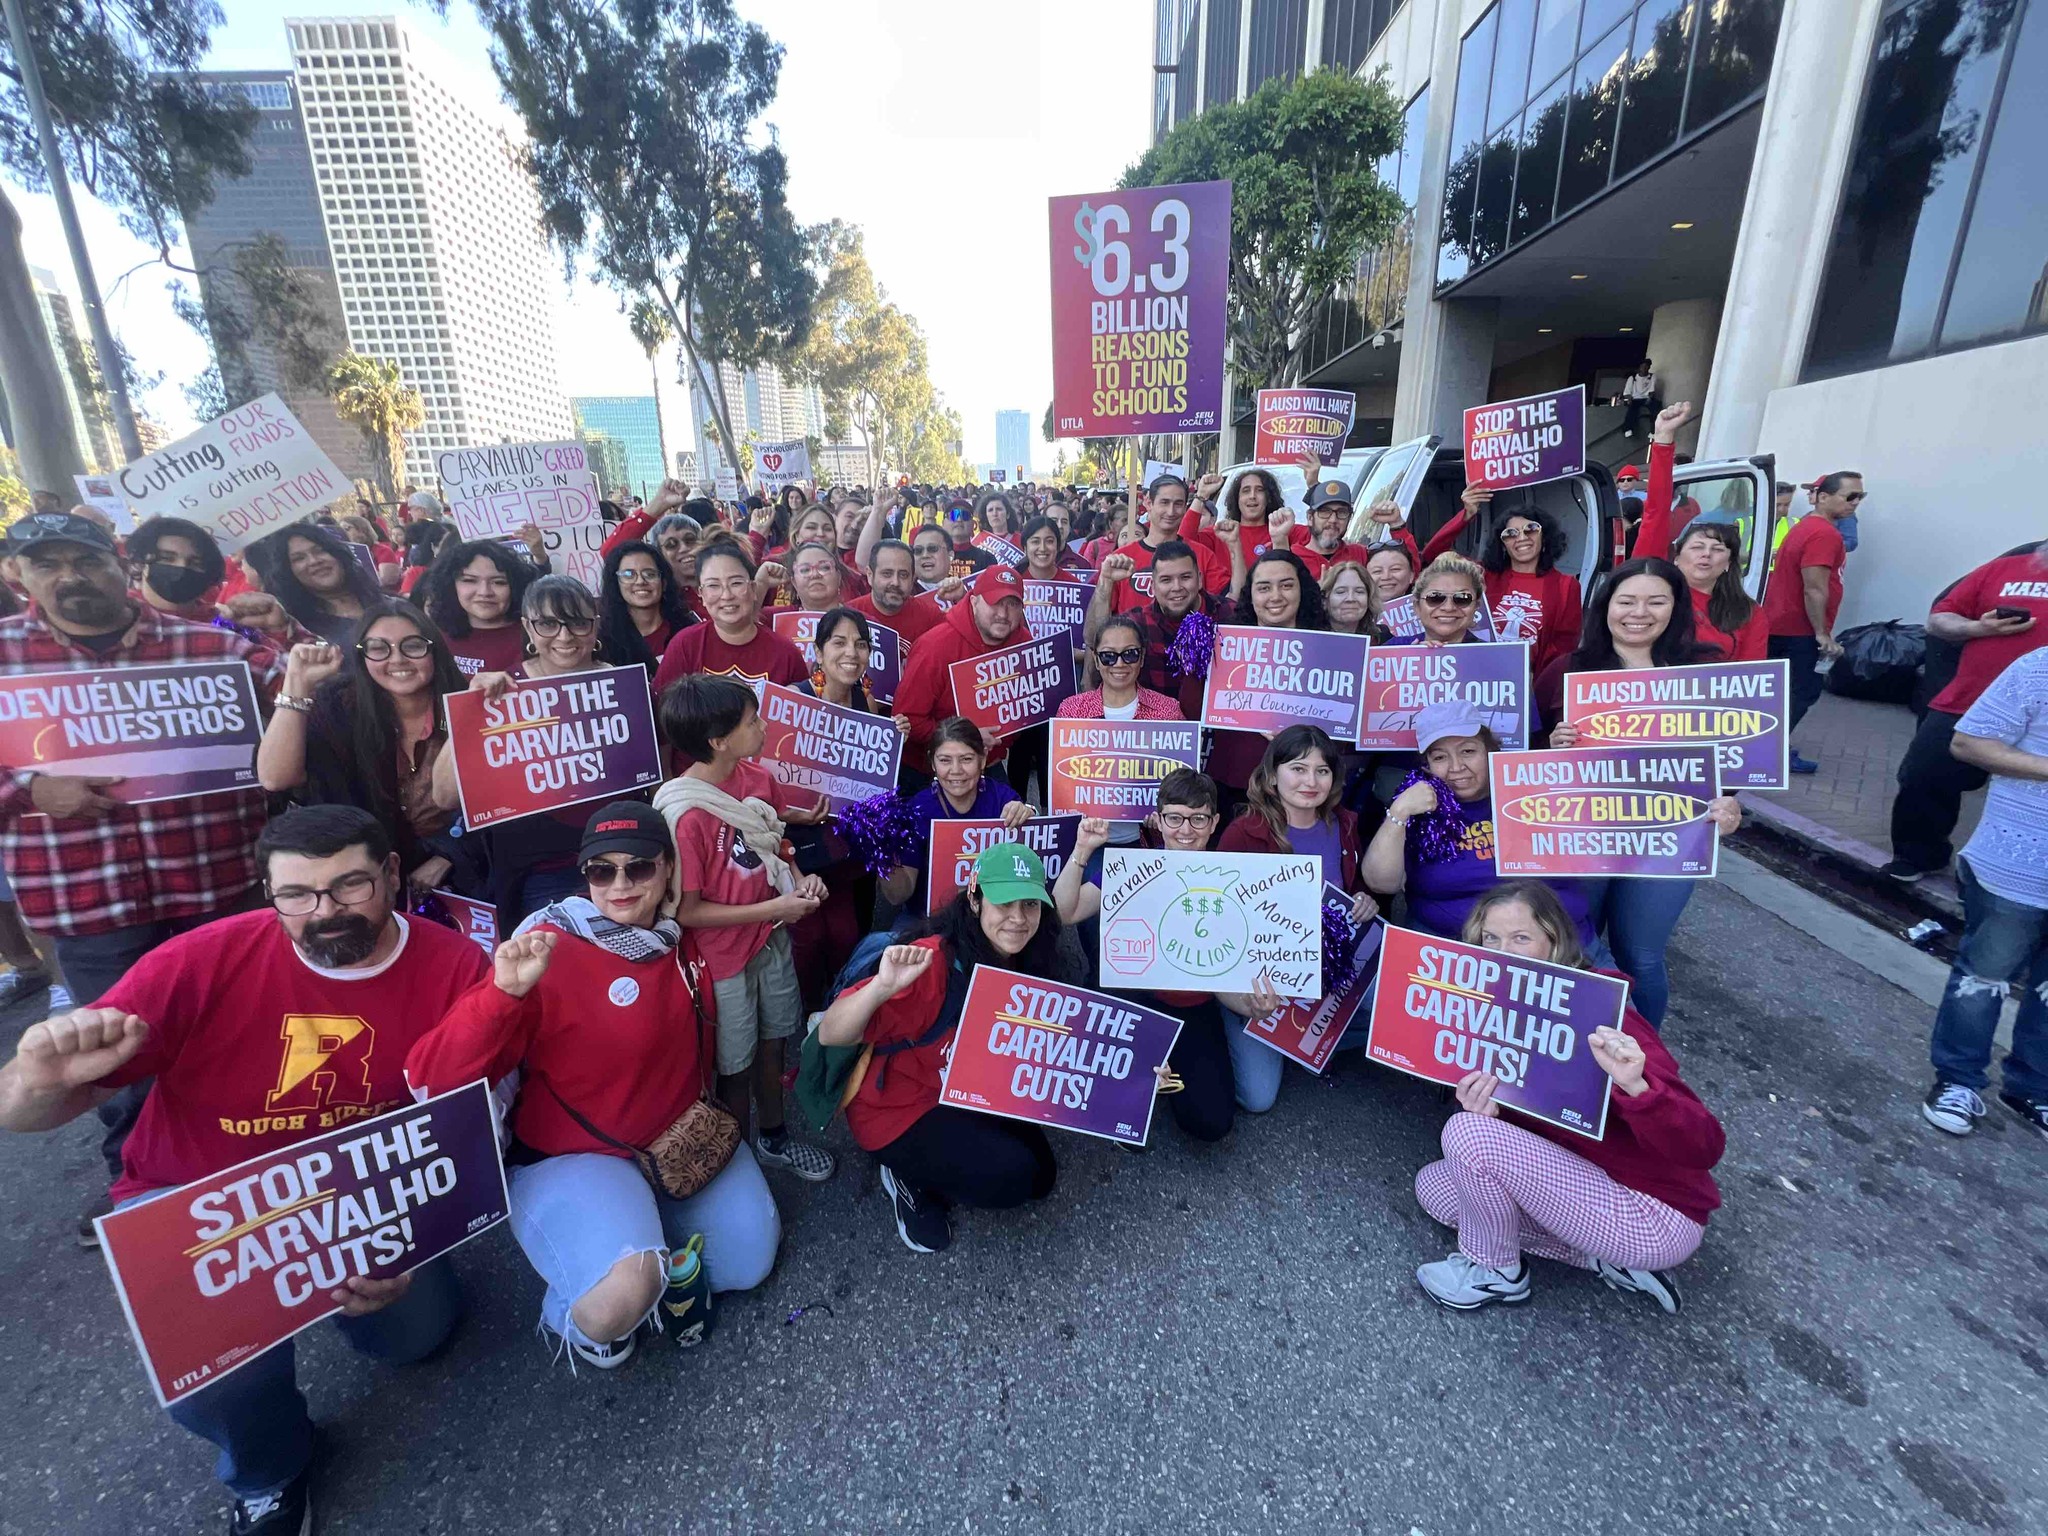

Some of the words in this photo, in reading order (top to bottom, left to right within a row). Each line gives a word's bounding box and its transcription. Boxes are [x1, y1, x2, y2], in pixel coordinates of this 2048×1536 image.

[1074, 199, 1191, 297] $6.3
[1092, 296, 1188, 334] BILLION
[1092, 330, 1189, 363] REASONS
[1092, 362, 1120, 390] TO
[1131, 359, 1187, 388] FUND
[1092, 387, 1187, 417] SCHOOLS
[1195, 411, 1214, 419] SEIU
[1264, 396, 1301, 412] LAUSD
[1303, 397, 1327, 412] WILL
[1328, 398, 1350, 415] HAVE
[221, 402, 274, 434] OUR
[1061, 417, 1084, 430] UTLA
[1178, 418, 1203, 427] LOCAL
[1204, 418, 1214, 427] 99
[1270, 418, 1305, 435] $6.27
[1306, 418, 1343, 436] BILLION
[1475, 408, 1514, 435] STOP
[1517, 399, 1557, 427] THE
[1273, 440, 1285, 454] IN
[1287, 439, 1334, 456] RESERVES
[1471, 424, 1563, 460] CARVALHO
[119, 443, 225, 500] Cutting
[229, 418, 296, 458] FUNDS
[544, 446, 584, 472] GREED
[1485, 452, 1539, 481] CUTS!
[460, 478, 518, 500] LEAVES
[522, 475, 544, 488] US
[553, 473, 568, 486] IN
[217, 467, 334, 538] EDUCATION
[453, 483, 601, 540] NEED!
[983, 536, 1007, 552] STOP
[1004, 546, 1023, 564] THE
[1056, 587, 1081, 604] THE
[1025, 605, 1083, 624] ARVALHO
[975, 654, 1020, 685] STOP
[1021, 642, 1055, 670] THE
[1221, 636, 1270, 664] GIVE
[1273, 639, 1304, 665] US
[1245, 663, 1305, 692] BACK
[1307, 668, 1354, 698] OUR
[1369, 656, 1421, 682] GIVE
[1424, 655, 1457, 681] US
[975, 665, 1061, 710] CARVALHO
[1399, 681, 1461, 708] BACK
[1465, 681, 1516, 708] OUR
[1576, 681, 1646, 704] LAUSD
[1650, 677, 1706, 701] WILL
[1710, 674, 1775, 698] HAVE
[483, 687, 560, 728] STOP
[562, 678, 619, 715] THE
[998, 695, 1045, 724] CUTS!
[1224, 690, 1252, 711] PSA
[1260, 693, 1333, 719] Counselors
[63, 704, 245, 748] NUESTROS
[768, 695, 895, 752] DEVUÉLVENOS
[1590, 713, 1656, 740] $6.27
[1660, 711, 1760, 737] BILLION
[483, 713, 630, 768] CARVALHO
[794, 731, 890, 776] NUESTROS
[1059, 729, 1109, 748] LAUSD
[1112, 730, 1149, 749] WILL
[1152, 732, 1193, 750] HAVE
[525, 751, 607, 794] CUTS!
[778, 760, 822, 786] SPED
[1069, 756, 1115, 779] $6.27
[1503, 761, 1573, 786] LAUSD
[1577, 760, 1635, 783] WILL
[1639, 758, 1706, 783] HAVE
[1075, 786, 1090, 804] IN
[1094, 787, 1160, 806] RESERVE
[1520, 795, 1585, 824] $6.27
[1591, 795, 1695, 822] BILLION
[473, 811, 492, 823] UTLA
[1022, 824, 1060, 851] THE
[1531, 833, 1555, 855] IN
[1558, 832, 1678, 857] RESERVES
[1013, 856, 1030, 878] LA
[1105, 856, 1127, 878] Hey
[1504, 862, 1522, 870] UTLA
[1235, 861, 1315, 905] Hoarding
[1194, 917, 1209, 938] 6
[1254, 900, 1314, 944] Money
[1110, 938, 1152, 954] STOP
[1166, 938, 1236, 967] BILLION
[1254, 932, 1283, 944] our
[1256, 965, 1314, 993] Need!
[1417, 946, 1500, 992] STOP
[1506, 965, 1575, 1016] THE
[1005, 984, 1081, 1026] STOP
[1085, 1001, 1142, 1042] THE
[1404, 983, 1575, 1062] CARVALHO
[265, 1013, 376, 1113] R
[988, 1022, 1134, 1080] CARVALHO
[1373, 1045, 1391, 1059] UTLA
[1433, 1029, 1530, 1088] CUTS!
[949, 1088, 967, 1101] UTLA
[1011, 1063, 1094, 1111] CUTS!
[219, 1114, 307, 1136] ROUGH
[1561, 1113, 1582, 1125] LOCAL
[1562, 1108, 1582, 1119] SEIU
[1115, 1127, 1132, 1136] LOCAL
[189, 1151, 334, 1244] STOP
[338, 1113, 440, 1181] THE
[193, 1156, 458, 1298] CARVALHO
[272, 1220, 417, 1308] CUTS!
[173, 1365, 212, 1390] UTLA
